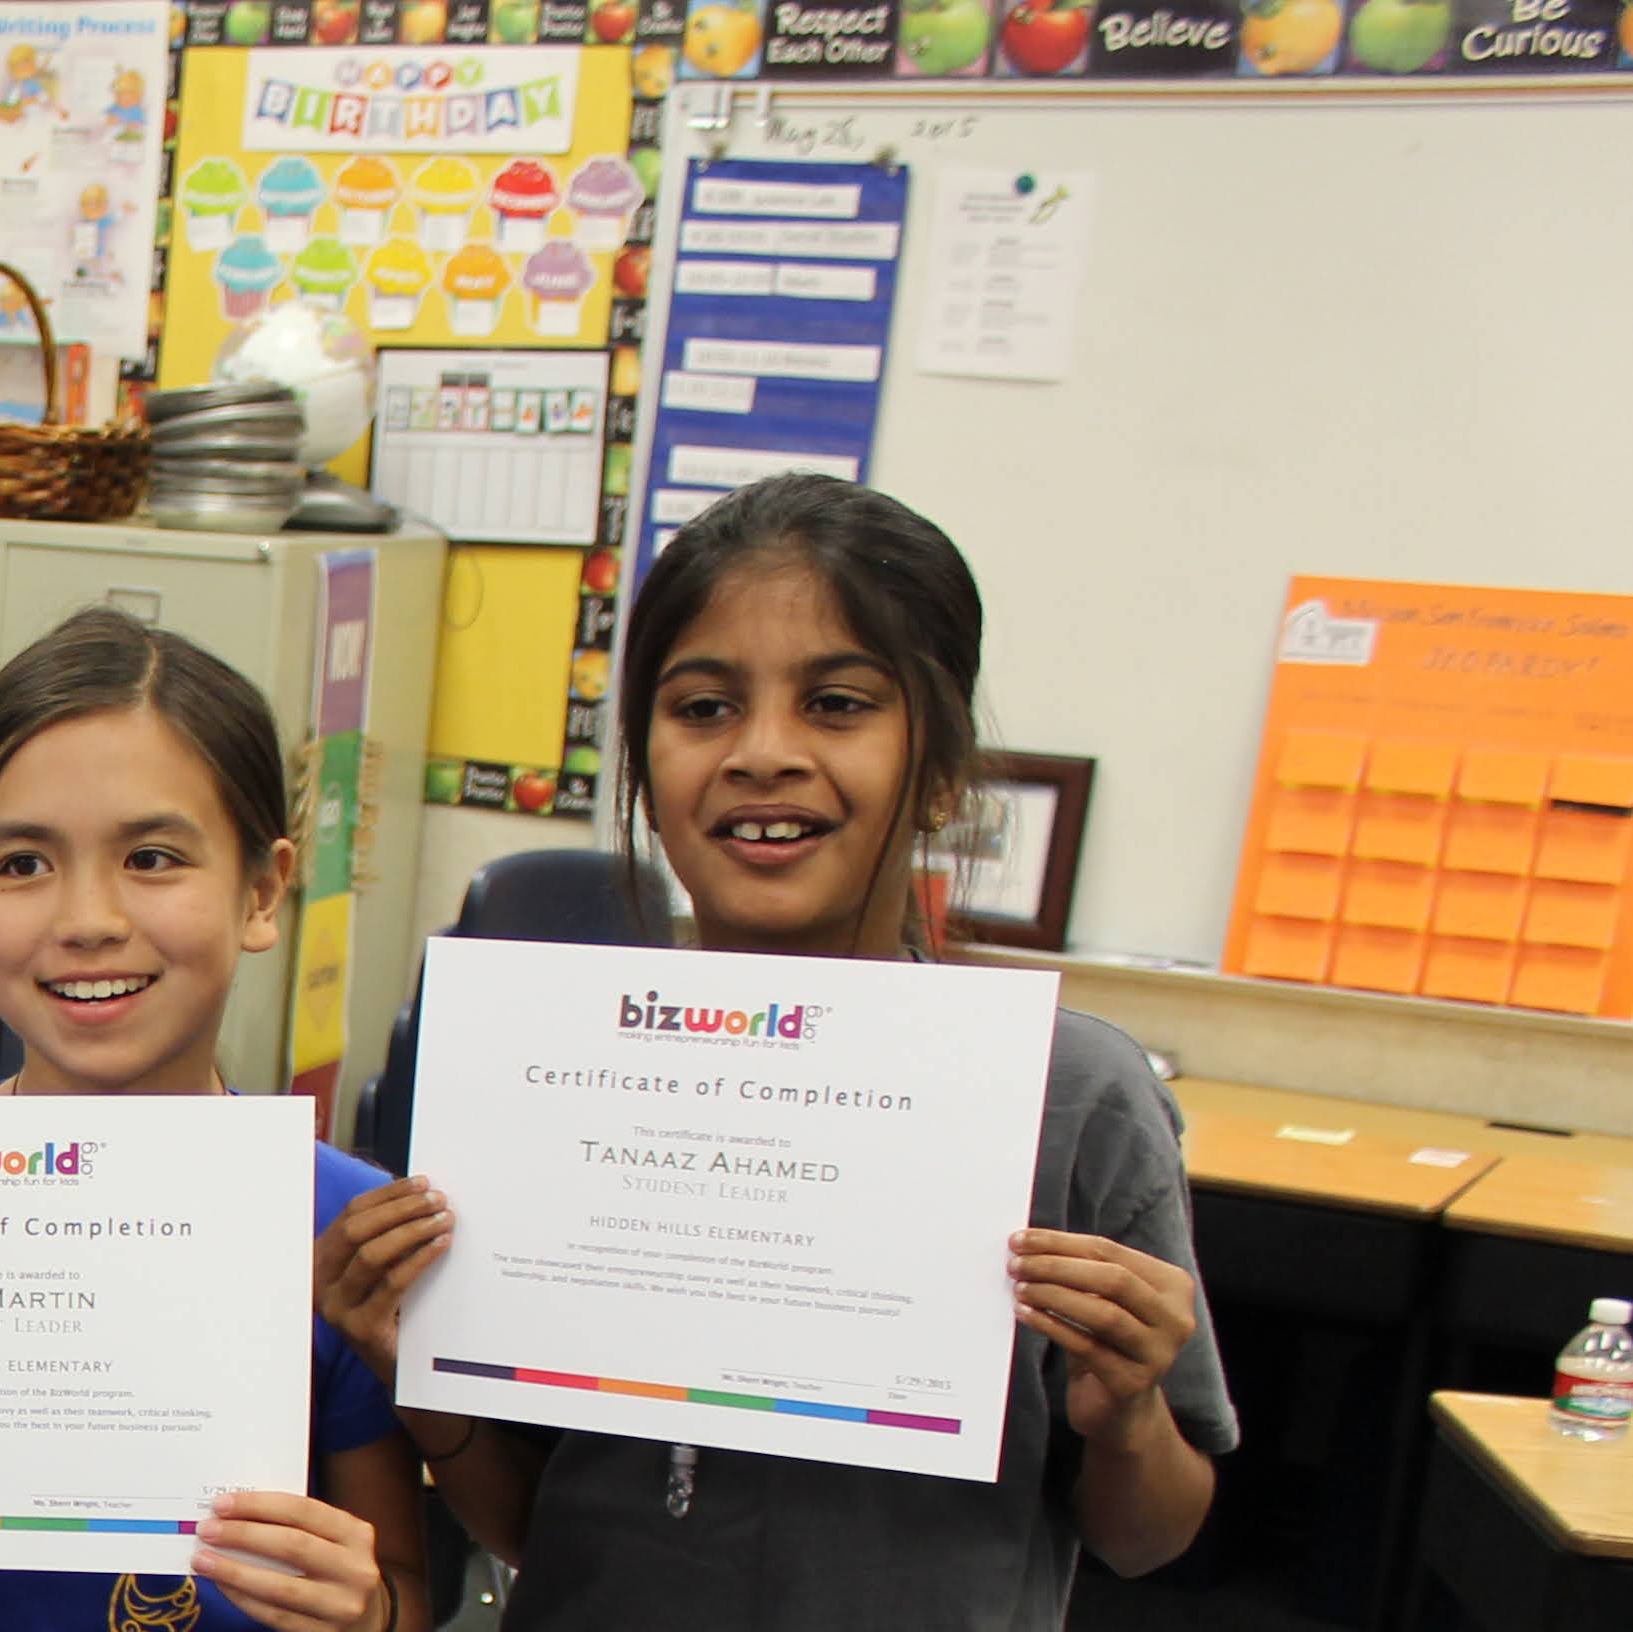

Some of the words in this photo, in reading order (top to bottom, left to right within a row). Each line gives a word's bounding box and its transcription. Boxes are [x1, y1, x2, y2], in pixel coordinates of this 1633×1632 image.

[775, 3, 889, 37] Respect
[1098, 11, 1230, 55] Believe
[768, 36, 819, 65] Each
[825, 31, 891, 64] Other
[1463, 23, 1605, 61] Curious
[256, 76, 560, 136] BIRTHDAY
[620, 991, 804, 1039] bizworld
[526, 1065, 678, 1093] Certificate
[696, 1078, 725, 1096] of
[740, 1081, 911, 1110] Completion
[580, 1140, 696, 1170] TANAAZ
[708, 1152, 839, 1182] AHAMED
[25, 1218, 191, 1240] Completion
[590, 1216, 650, 1231] HIDDEN
[657, 1222, 701, 1237] HILLS
[708, 1226, 815, 1246] ELEMENTARY
[8, 1360, 111, 1372] ELEMENTARY
